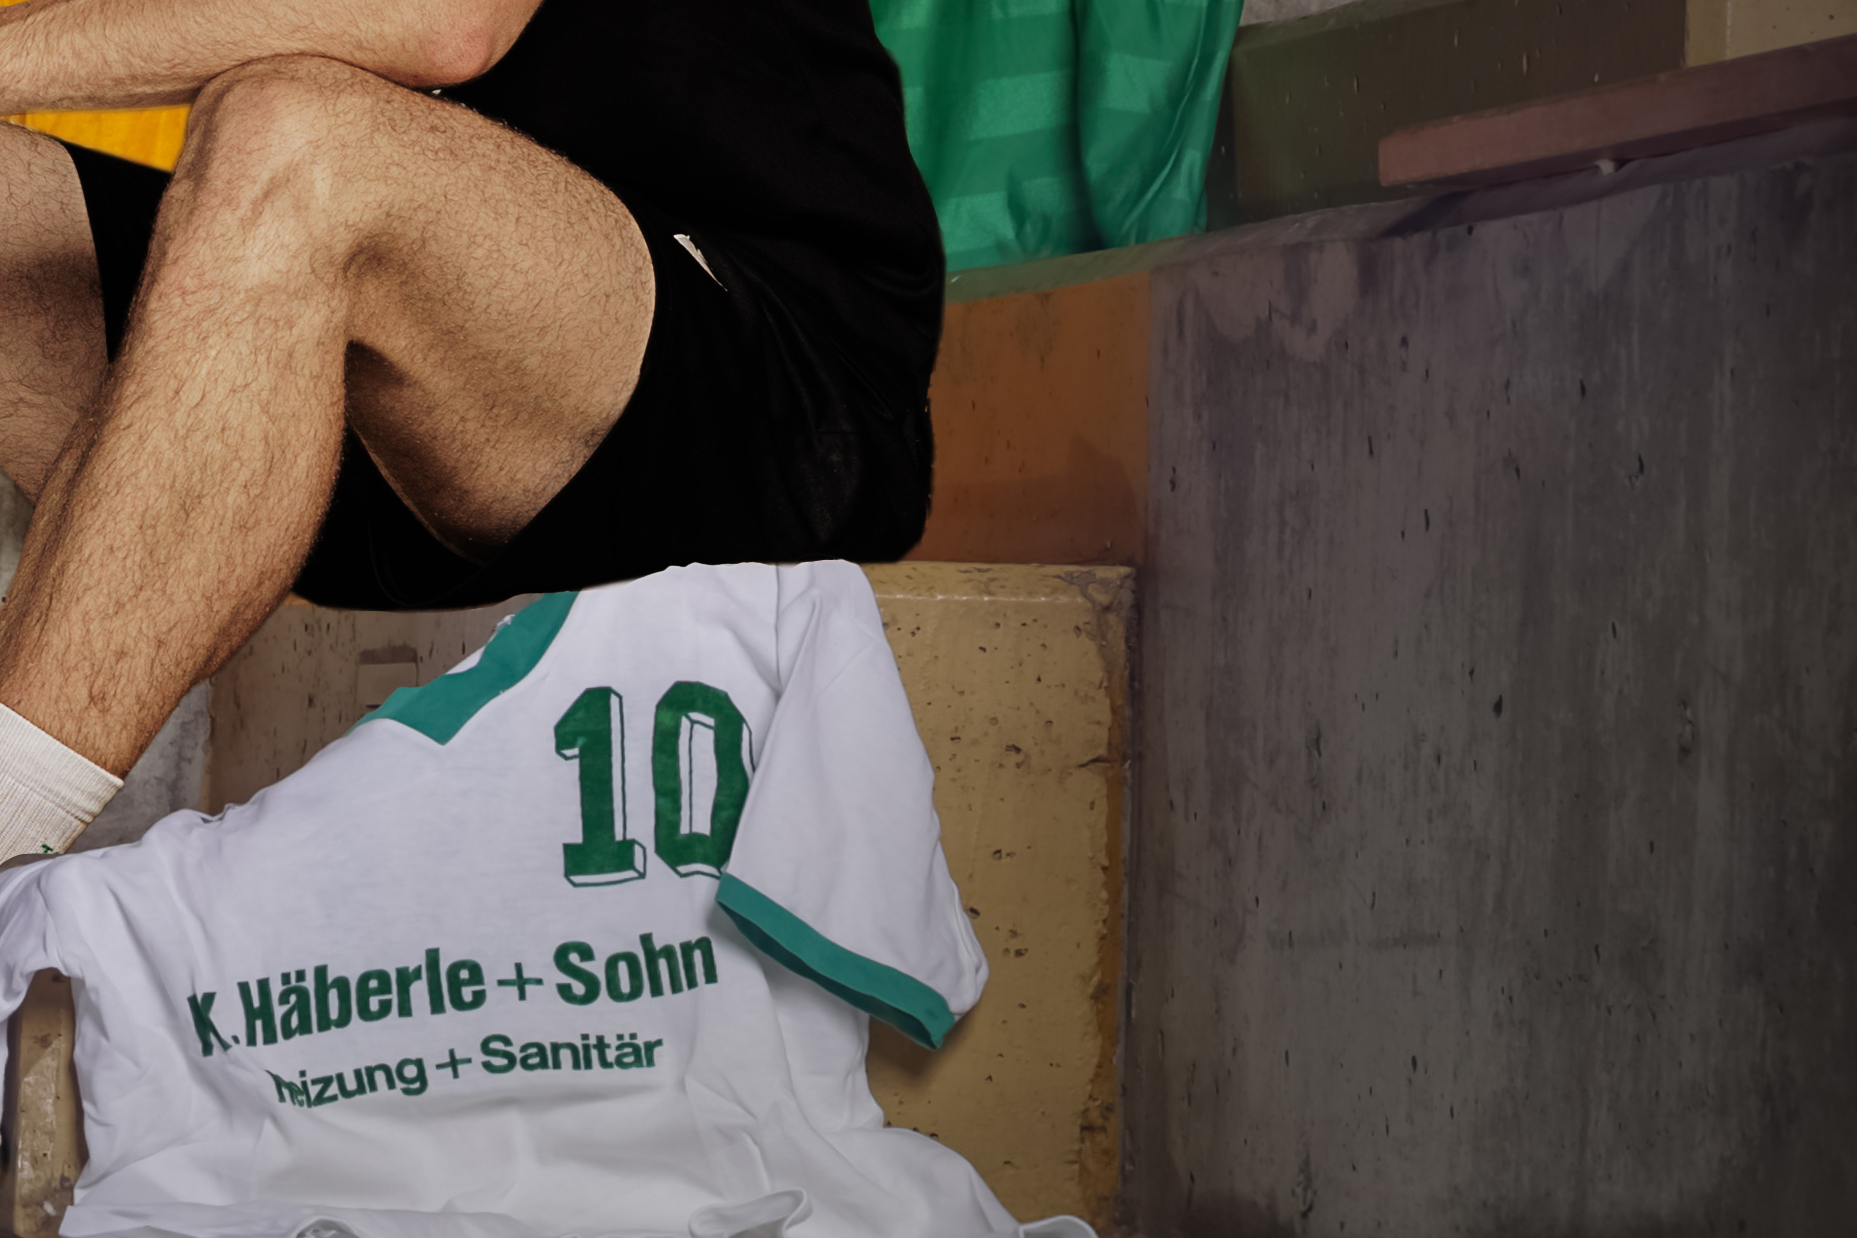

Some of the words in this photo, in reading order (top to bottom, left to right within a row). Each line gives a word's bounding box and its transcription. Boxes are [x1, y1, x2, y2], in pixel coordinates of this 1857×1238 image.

[554, 680, 755, 887] 10
[553, 932, 719, 1006] Sohn
[480, 1032, 664, 1074] Sanitär
